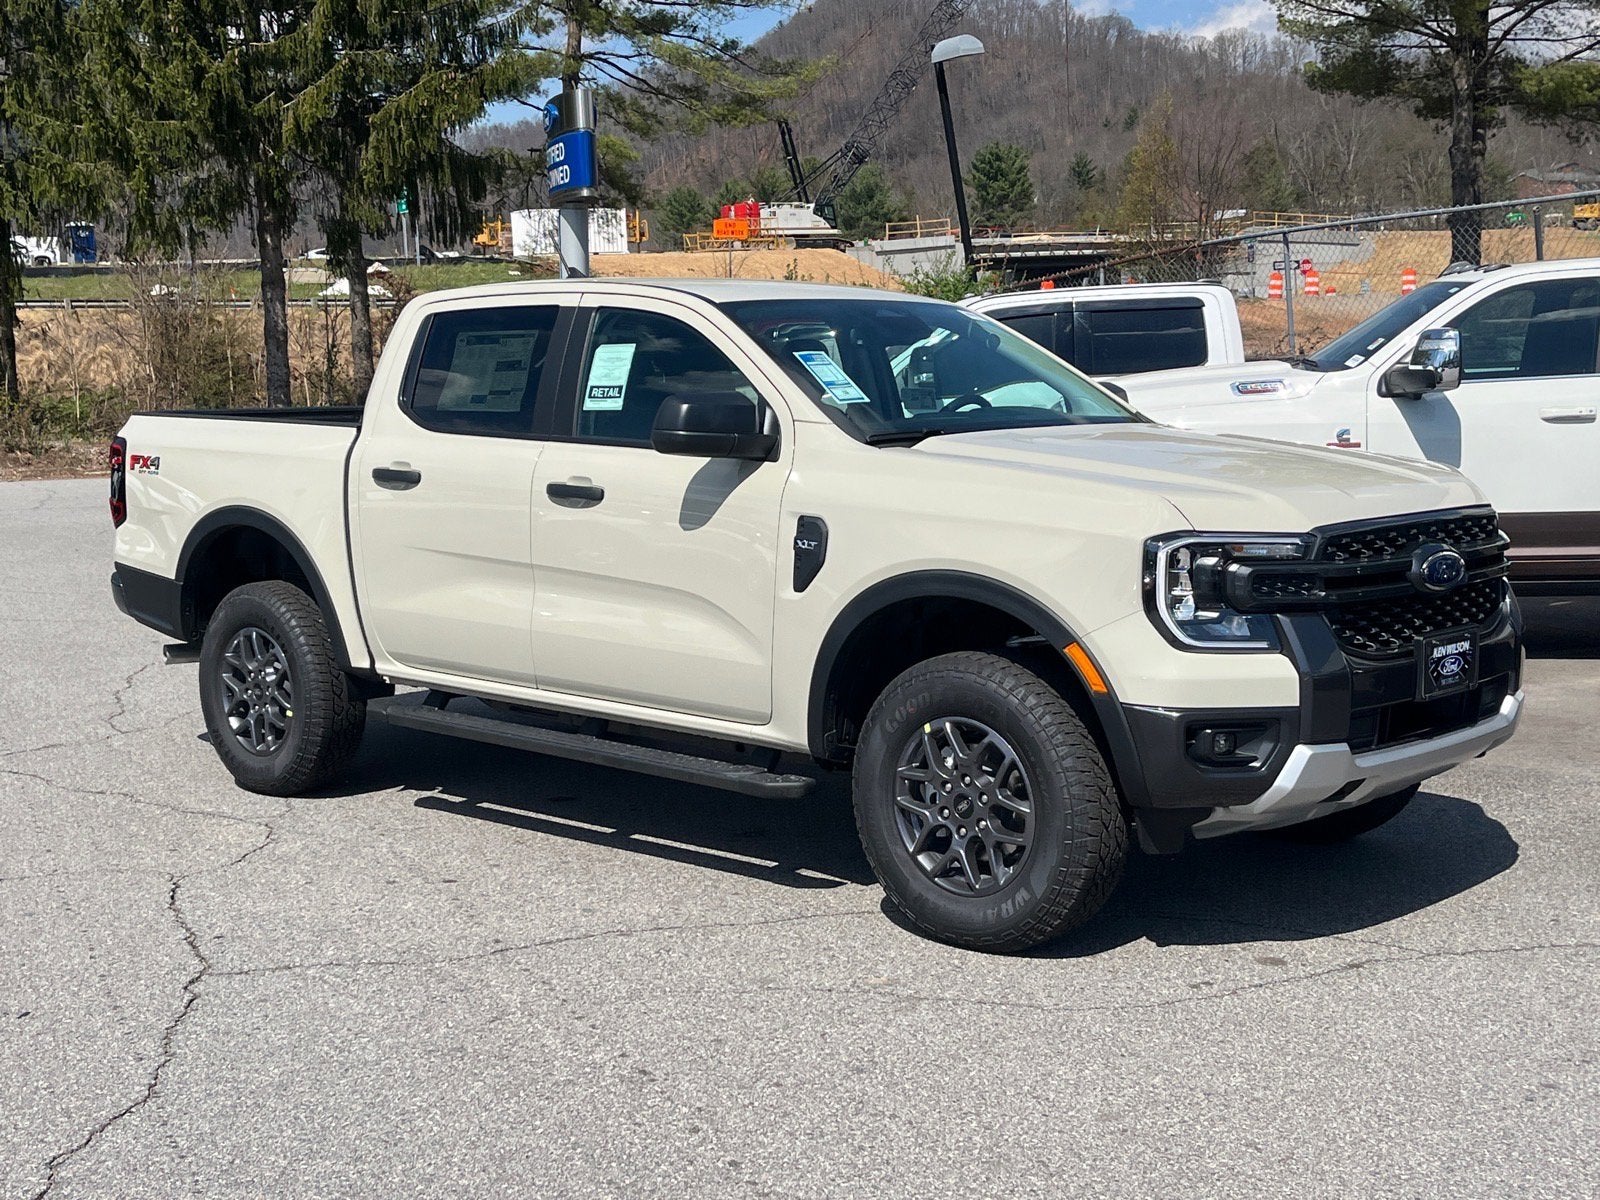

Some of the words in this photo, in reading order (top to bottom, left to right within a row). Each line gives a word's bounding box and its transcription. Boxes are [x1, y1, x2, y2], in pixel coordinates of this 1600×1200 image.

[591, 387, 621, 398] RETAIL
[130, 455, 160, 470] FX4
[796, 540, 818, 550] XLT
[1432, 646, 1447, 658] KEN
[1446, 640, 1470, 655] WILSON
[1442, 658, 1460, 673] Ford
